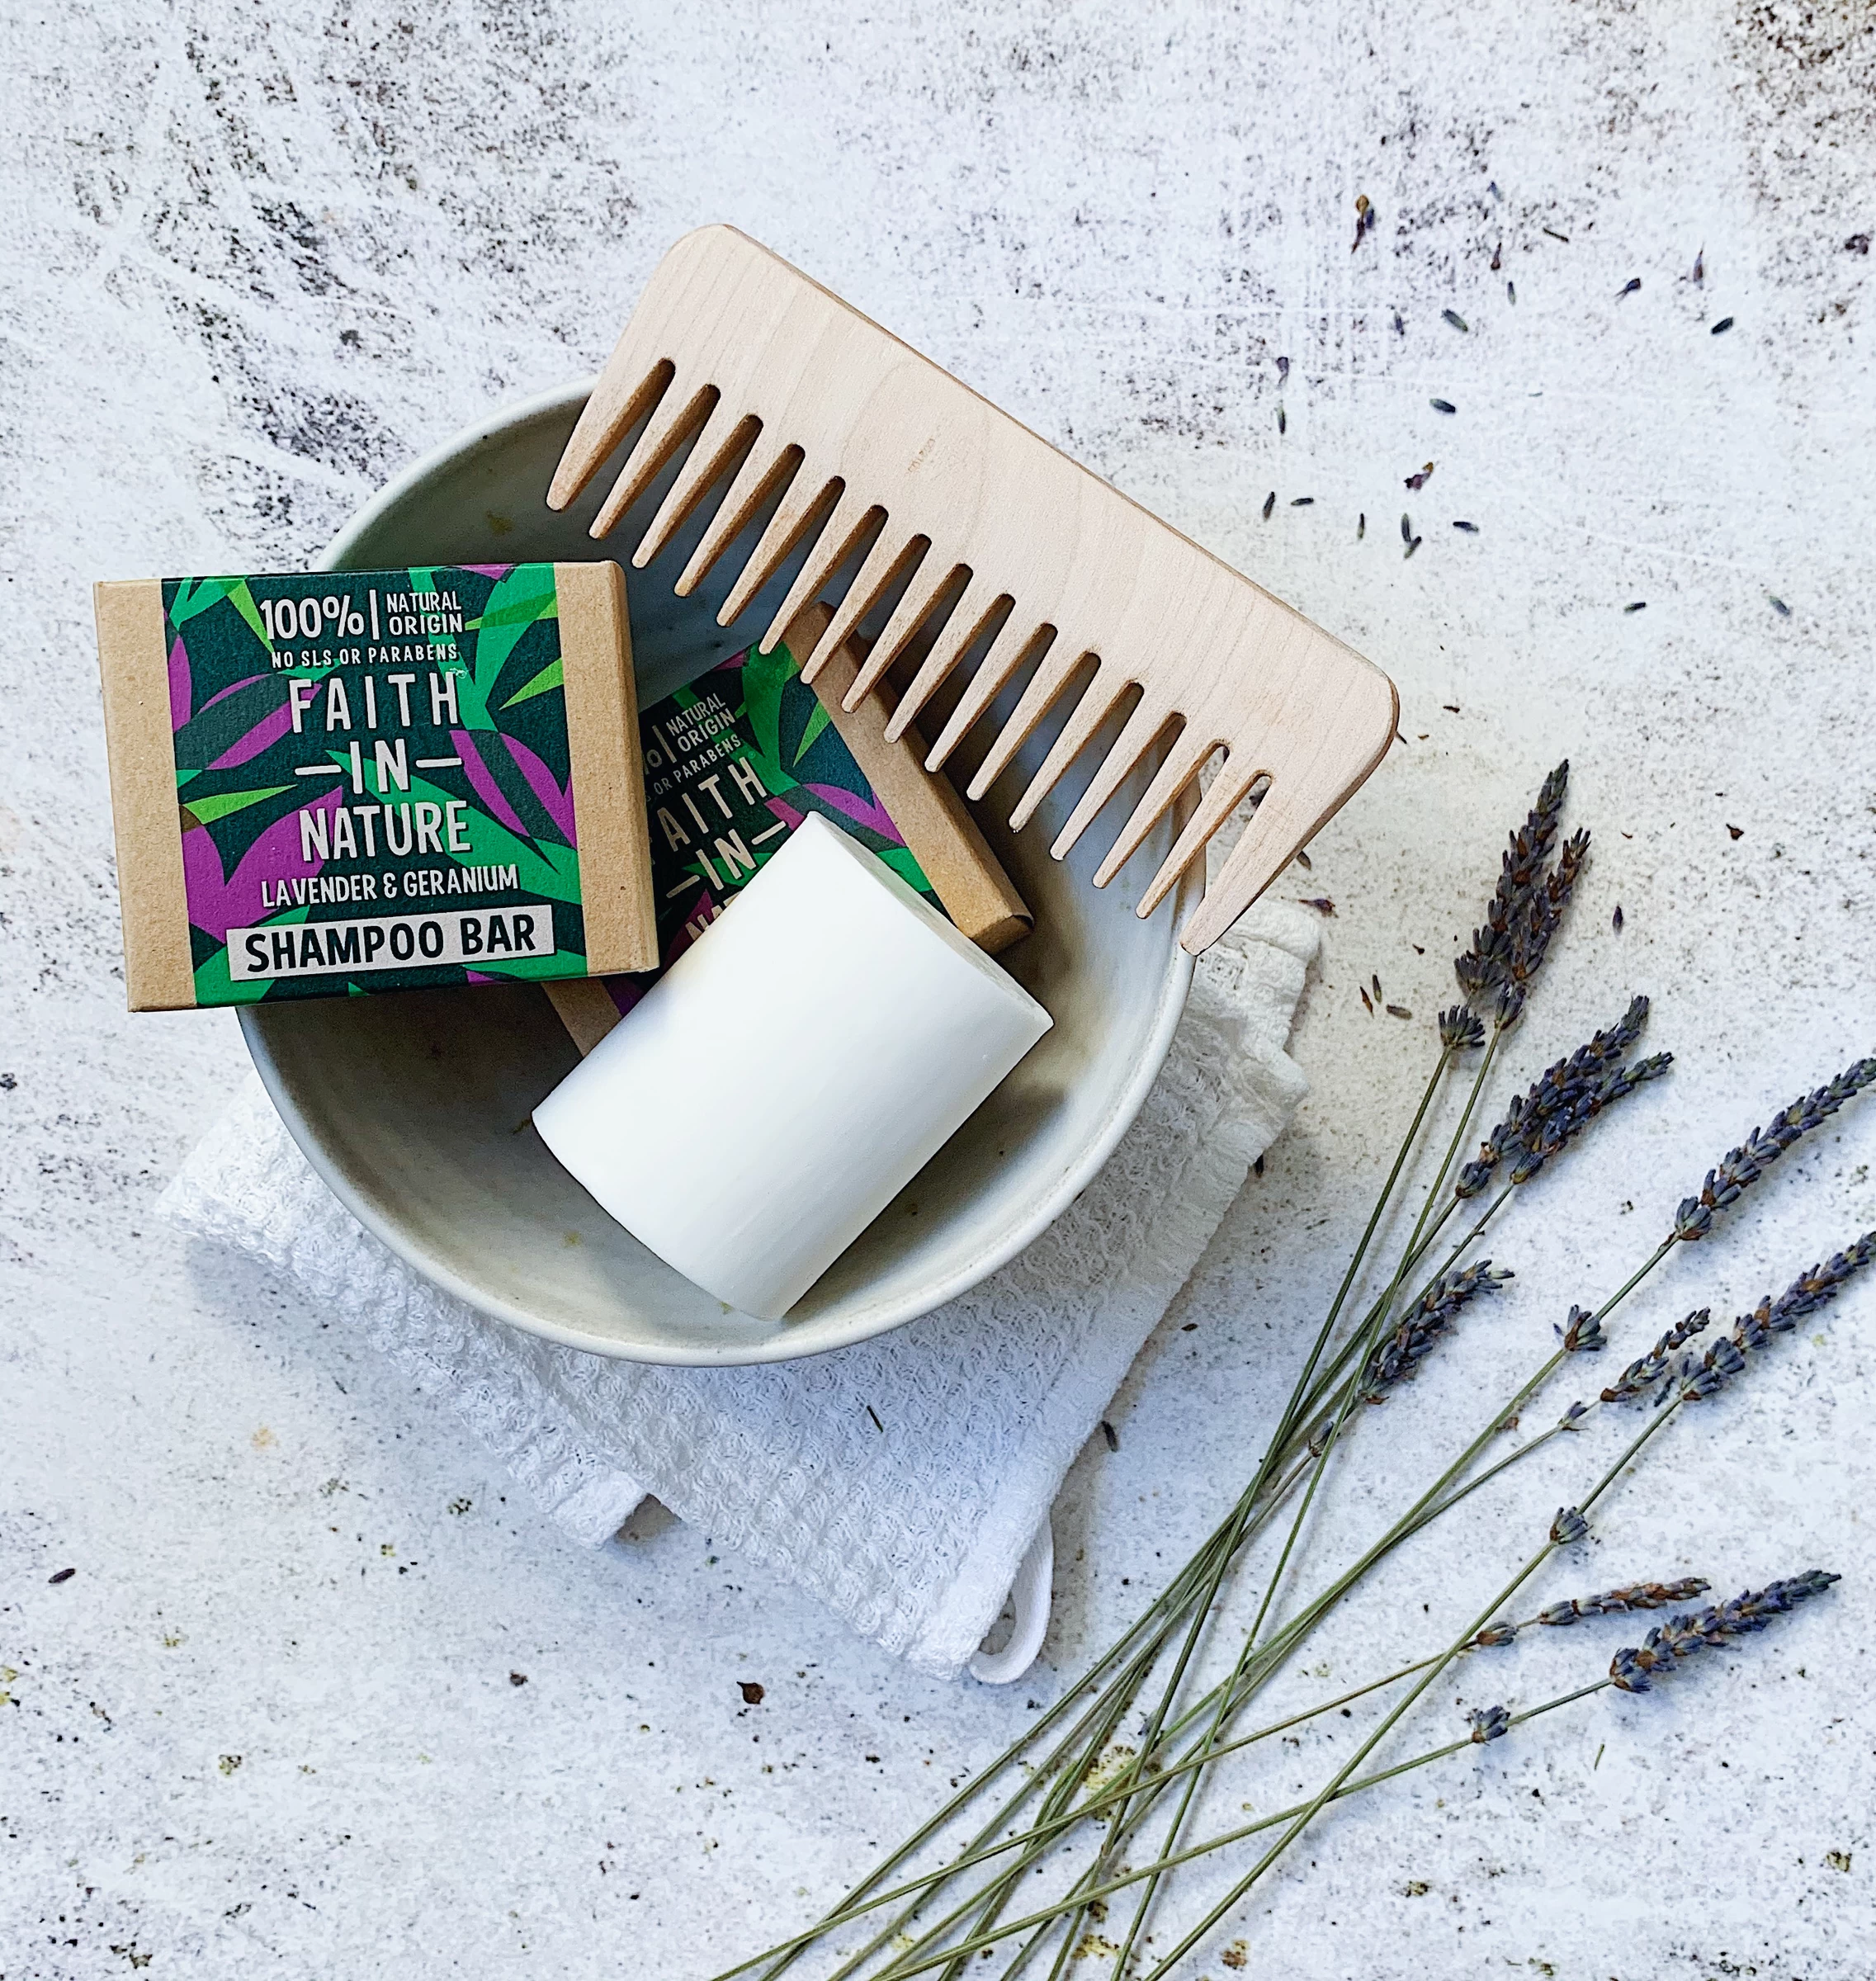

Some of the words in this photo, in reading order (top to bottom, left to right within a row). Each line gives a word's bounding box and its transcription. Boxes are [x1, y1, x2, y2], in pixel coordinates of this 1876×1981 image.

[260, 594, 365, 641] 100%
[386, 590, 461, 612] NATURAL
[389, 613, 463, 636] ORIGIN
[272, 651, 293, 668] NO
[301, 649, 331, 667] SLS
[339, 647, 361, 664] OR
[368, 643, 457, 664] PARABENS
[289, 671, 459, 733] FAITH
[665, 693, 726, 736] NATURAL
[677, 707, 736, 752] ORIGIN
[349, 738, 409, 794] IN
[653, 777, 673, 795] OR
[673, 734, 741, 782] PARABENS
[650, 756, 768, 853] AITH
[300, 800, 471, 863] NATURE
[695, 828, 757, 891] IN
[262, 873, 377, 908] LAVENDER
[382, 872, 398, 899] &
[404, 863, 518, 897] GERANIUM
[246, 920, 444, 972] SHAMPOO
[460, 914, 536, 956] BAR
